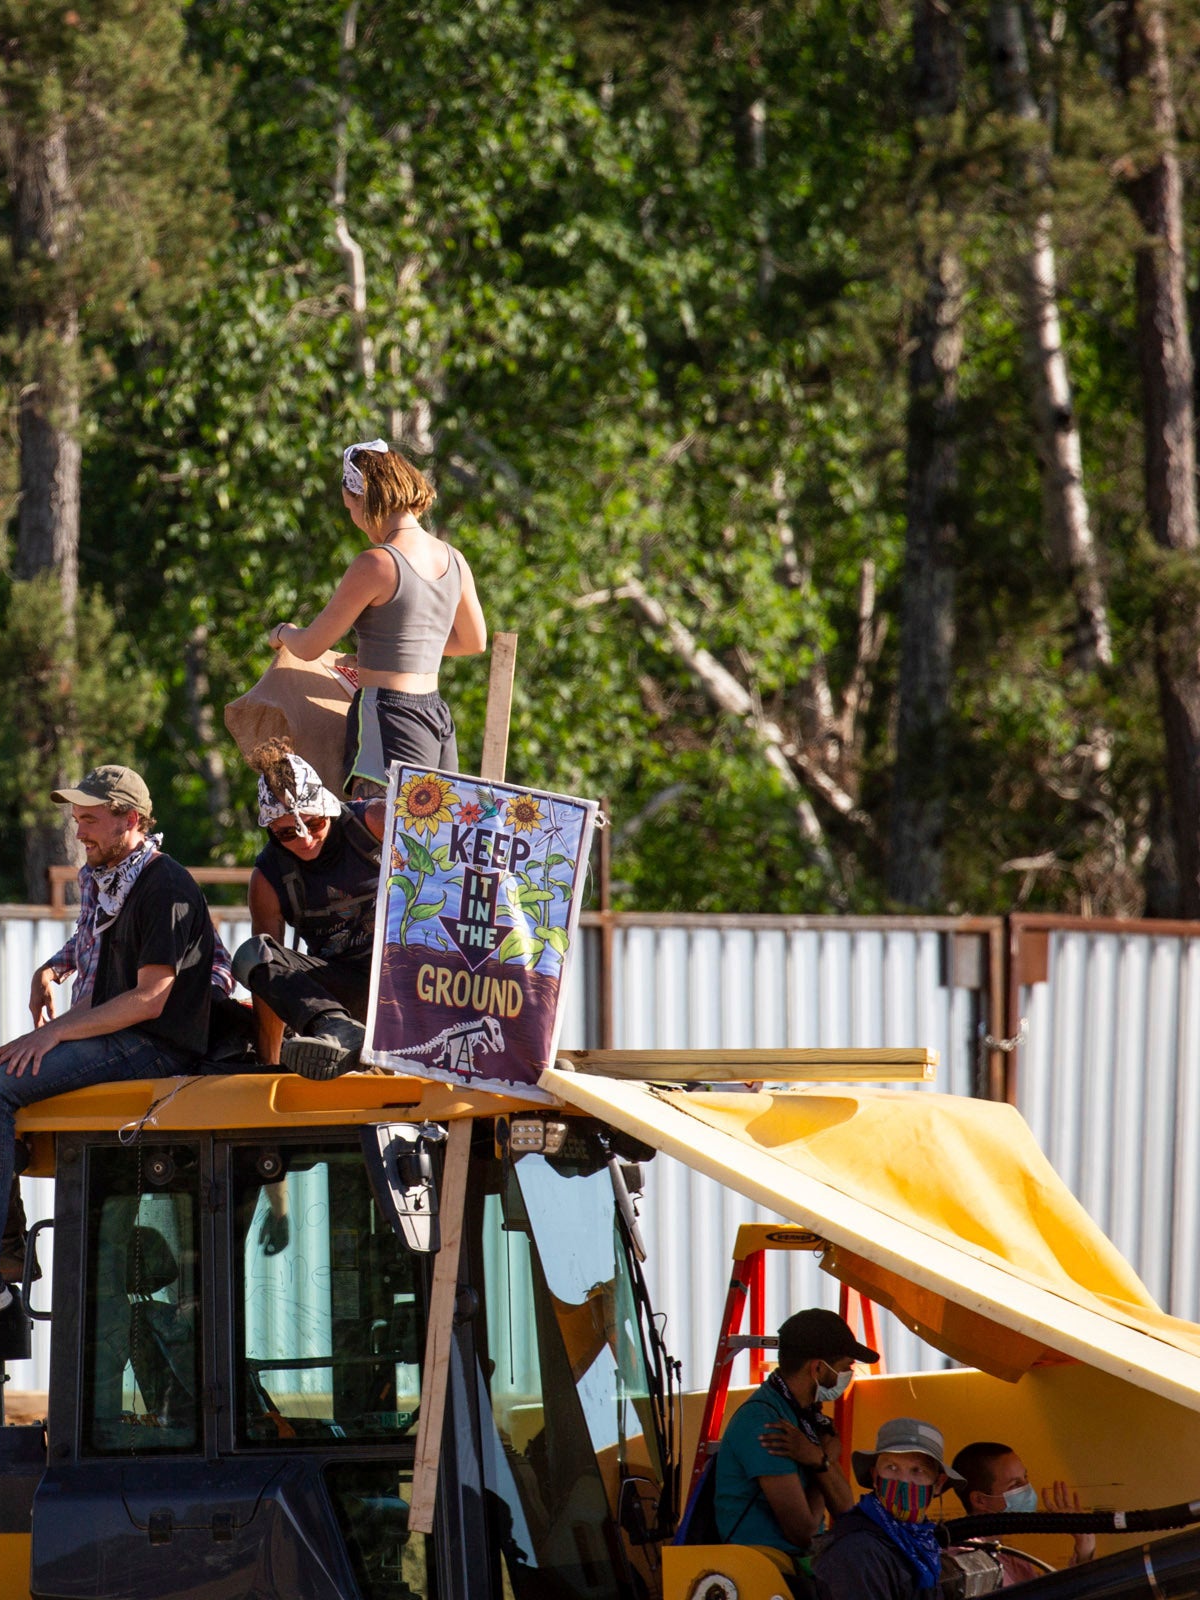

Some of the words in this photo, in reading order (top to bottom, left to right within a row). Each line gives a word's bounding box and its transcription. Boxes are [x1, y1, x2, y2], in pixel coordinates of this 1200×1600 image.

[448, 824, 531, 873] KEEP
[470, 875, 492, 898] IT
[467, 899, 490, 922] IN
[456, 923, 498, 950] THE
[417, 963, 523, 1018] GROUND
